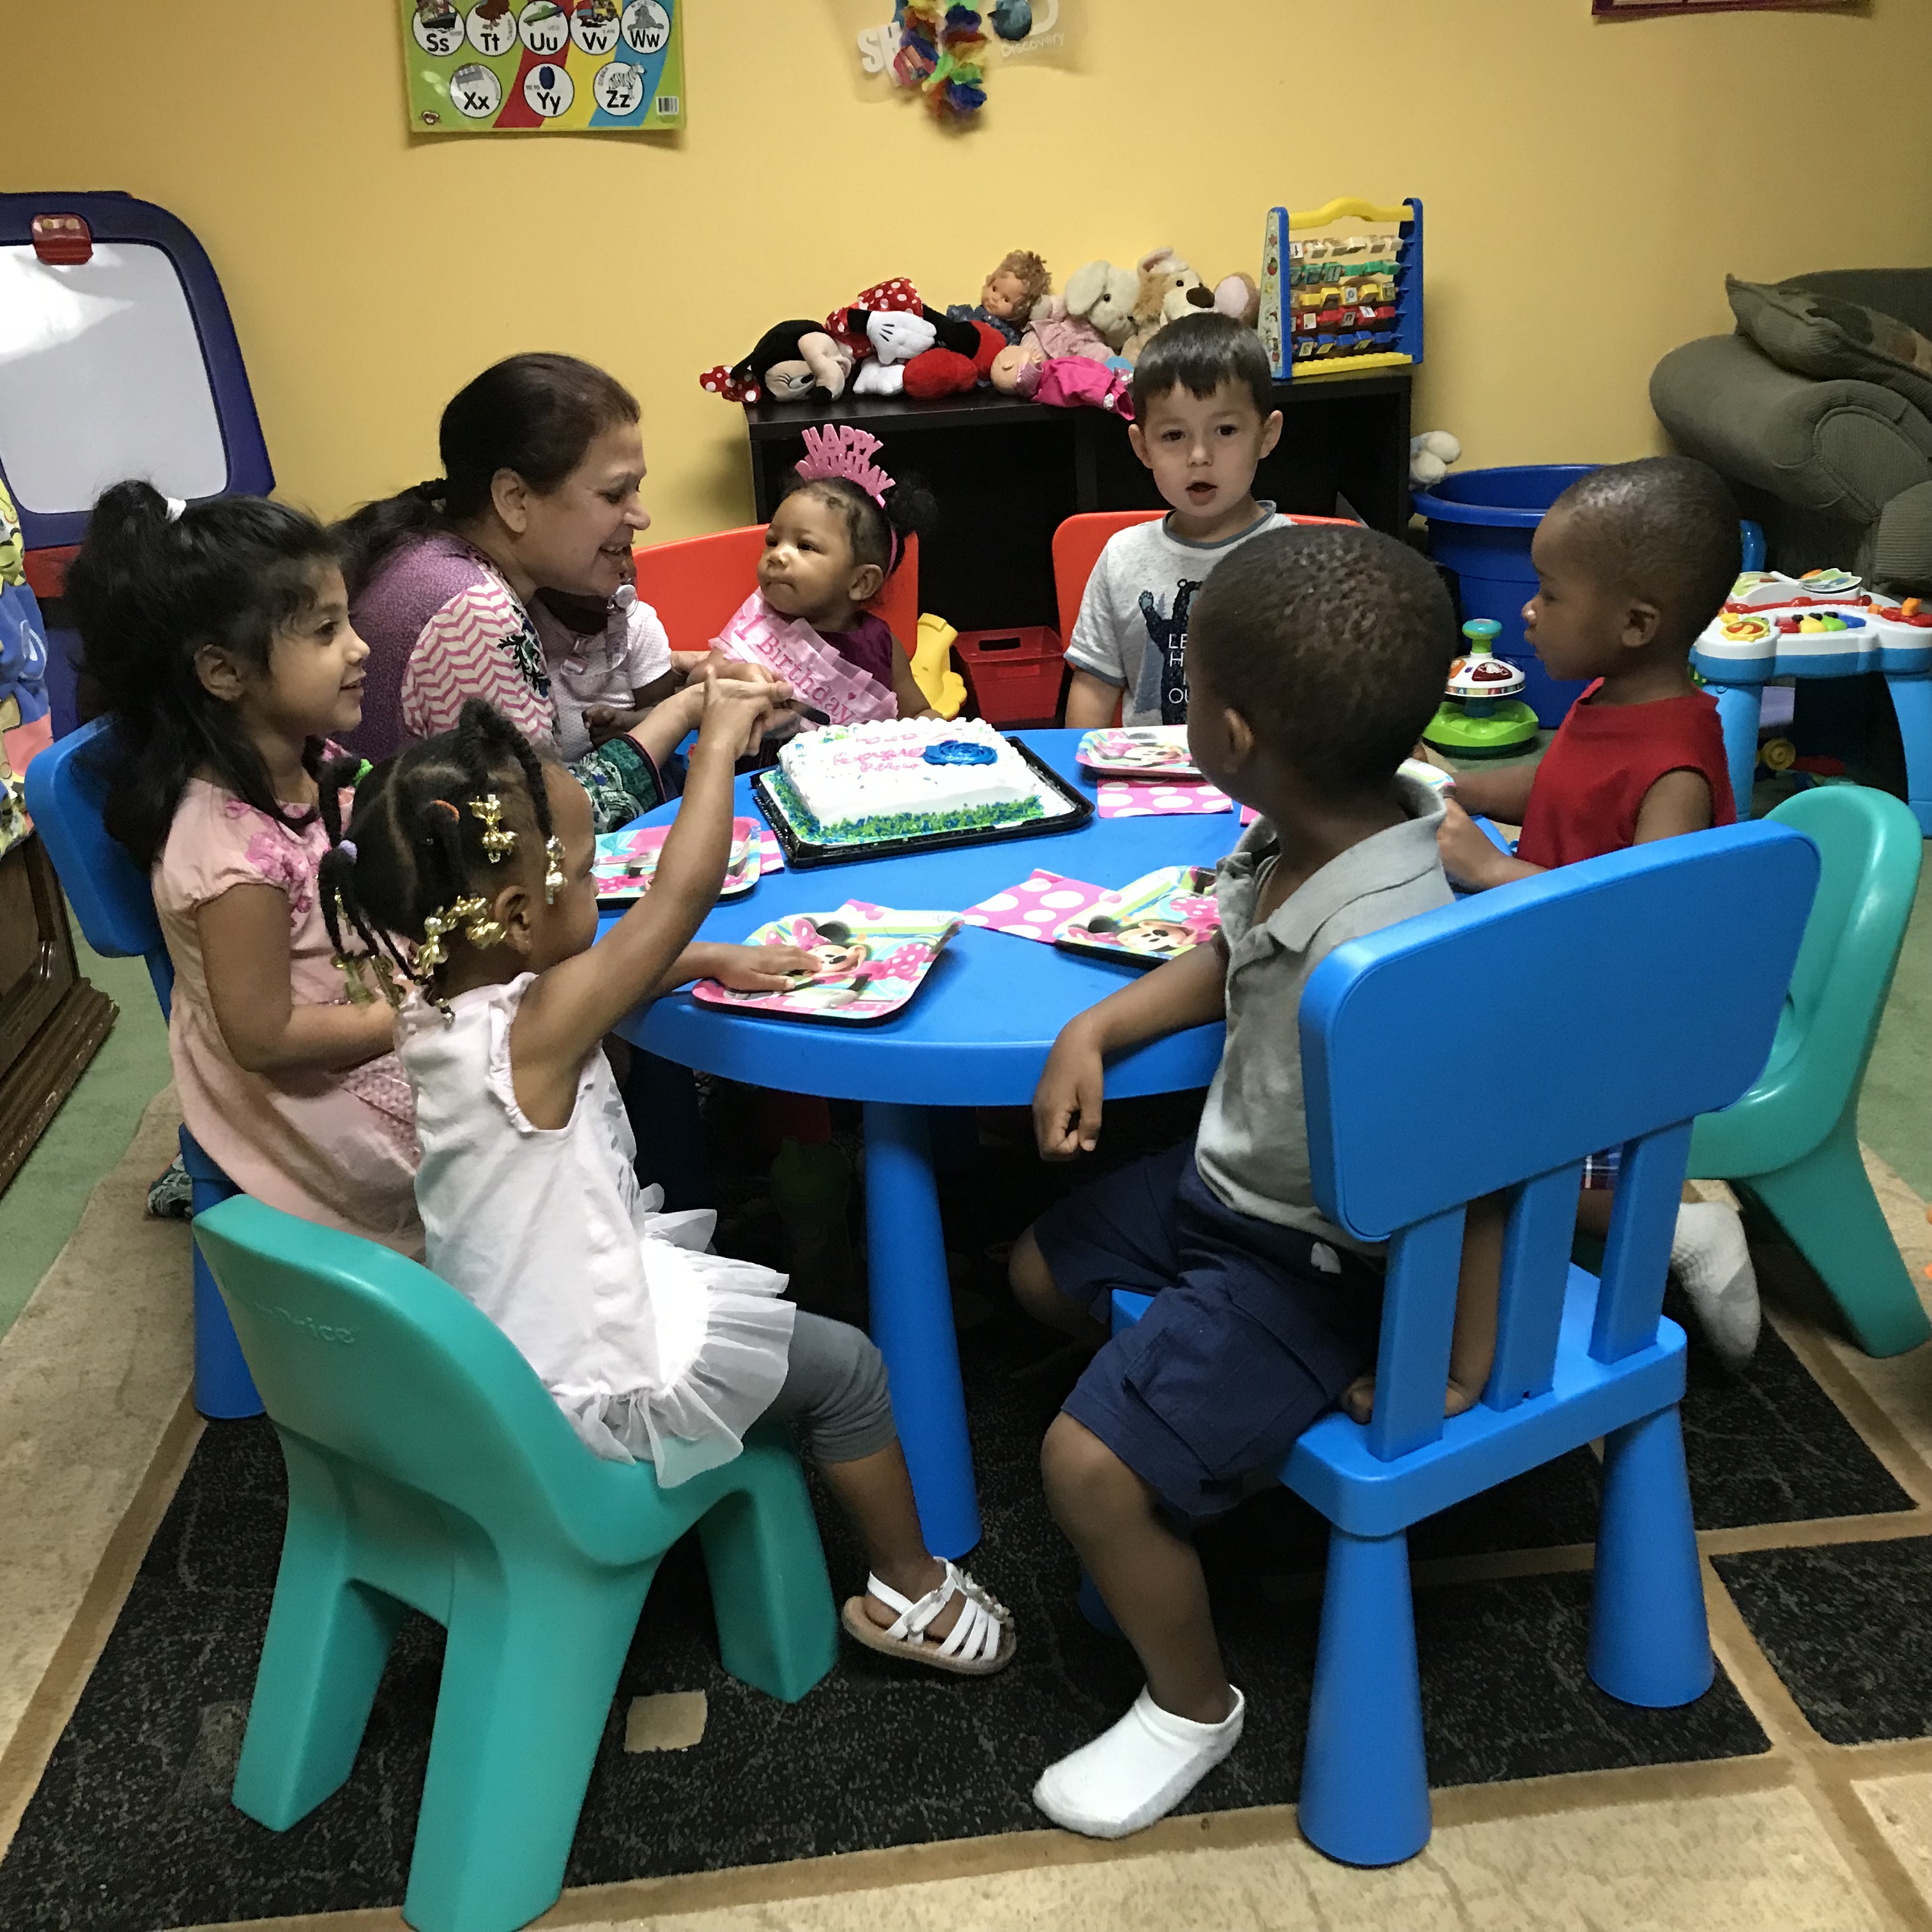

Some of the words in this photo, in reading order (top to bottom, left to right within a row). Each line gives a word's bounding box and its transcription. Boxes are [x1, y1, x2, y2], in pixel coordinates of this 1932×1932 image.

[426, 33, 450, 52] Ss
[480, 33, 500, 52] Tt
[530, 33, 558, 52] Uu
[582, 32, 608, 50] Vv
[630, 29, 660, 48] Ww
[463, 91, 490, 110] Xx
[537, 91, 561, 114] Yy
[606, 90, 631, 108] Zz
[801, 423, 884, 464] HAPPY
[755, 631, 857, 726] Birthday
